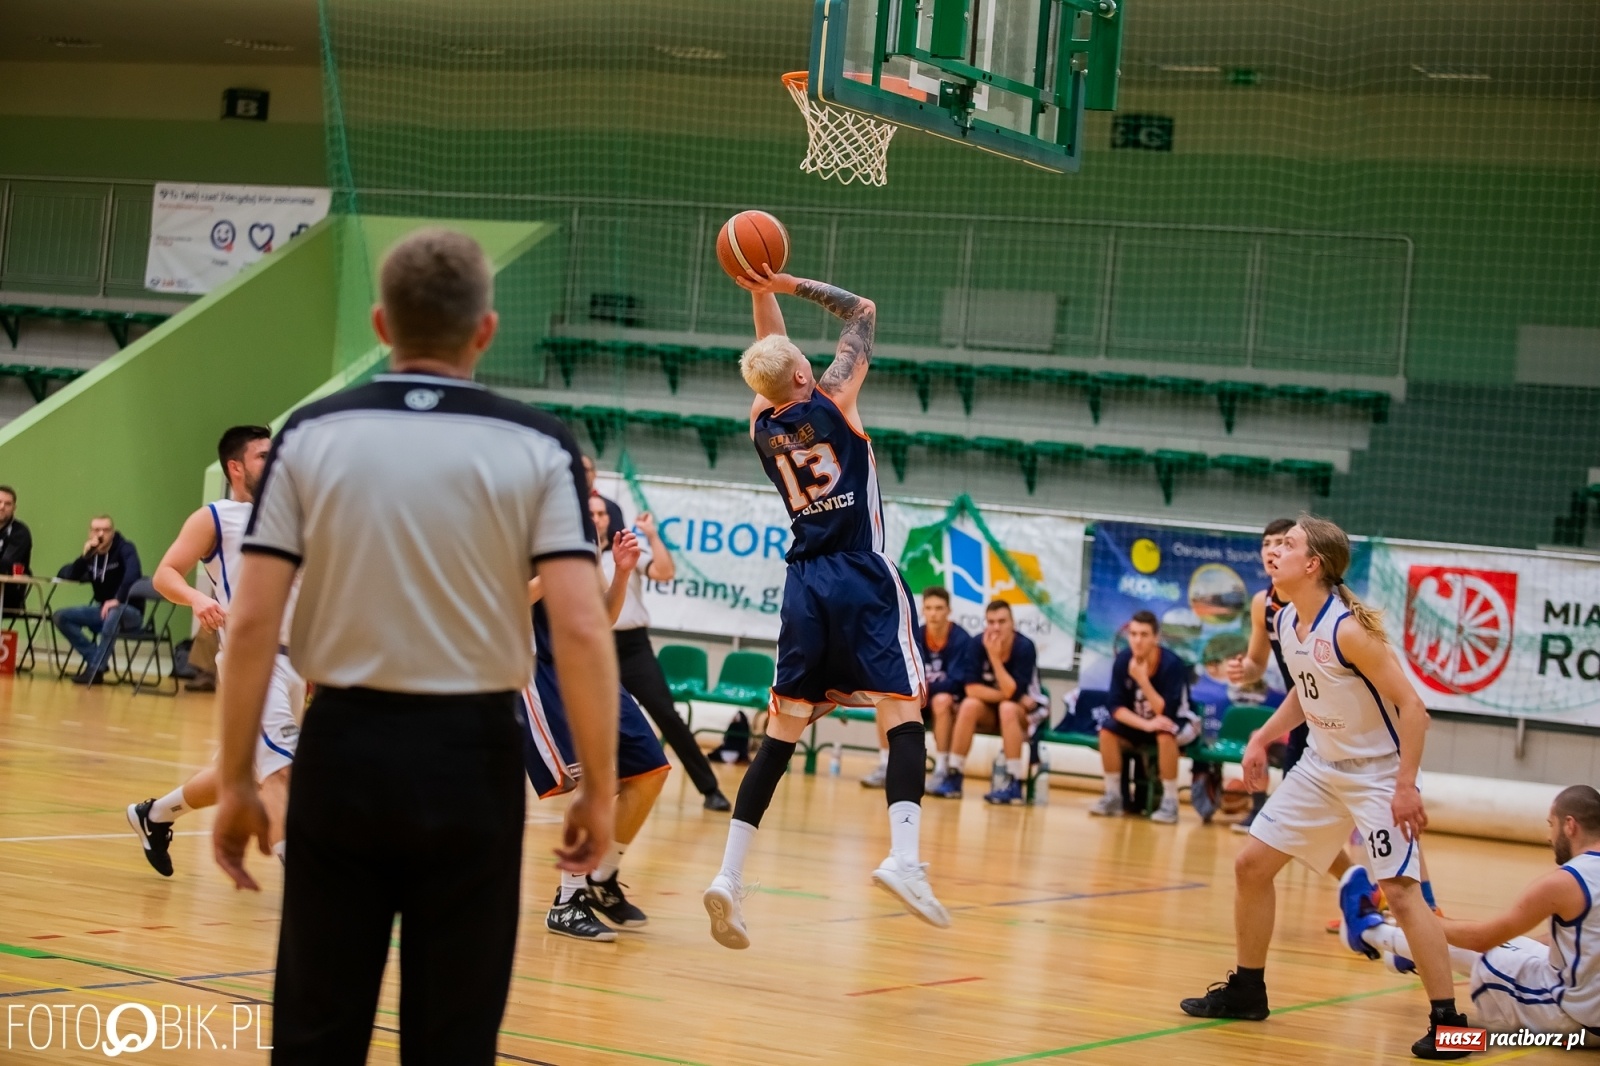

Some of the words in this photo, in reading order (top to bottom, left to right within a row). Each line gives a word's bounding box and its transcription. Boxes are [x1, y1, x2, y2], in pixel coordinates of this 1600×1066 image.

[236, 100, 259, 117] B
[775, 442, 841, 512] 13
[1298, 671, 1319, 700] 13
[1368, 829, 1392, 859] 13
